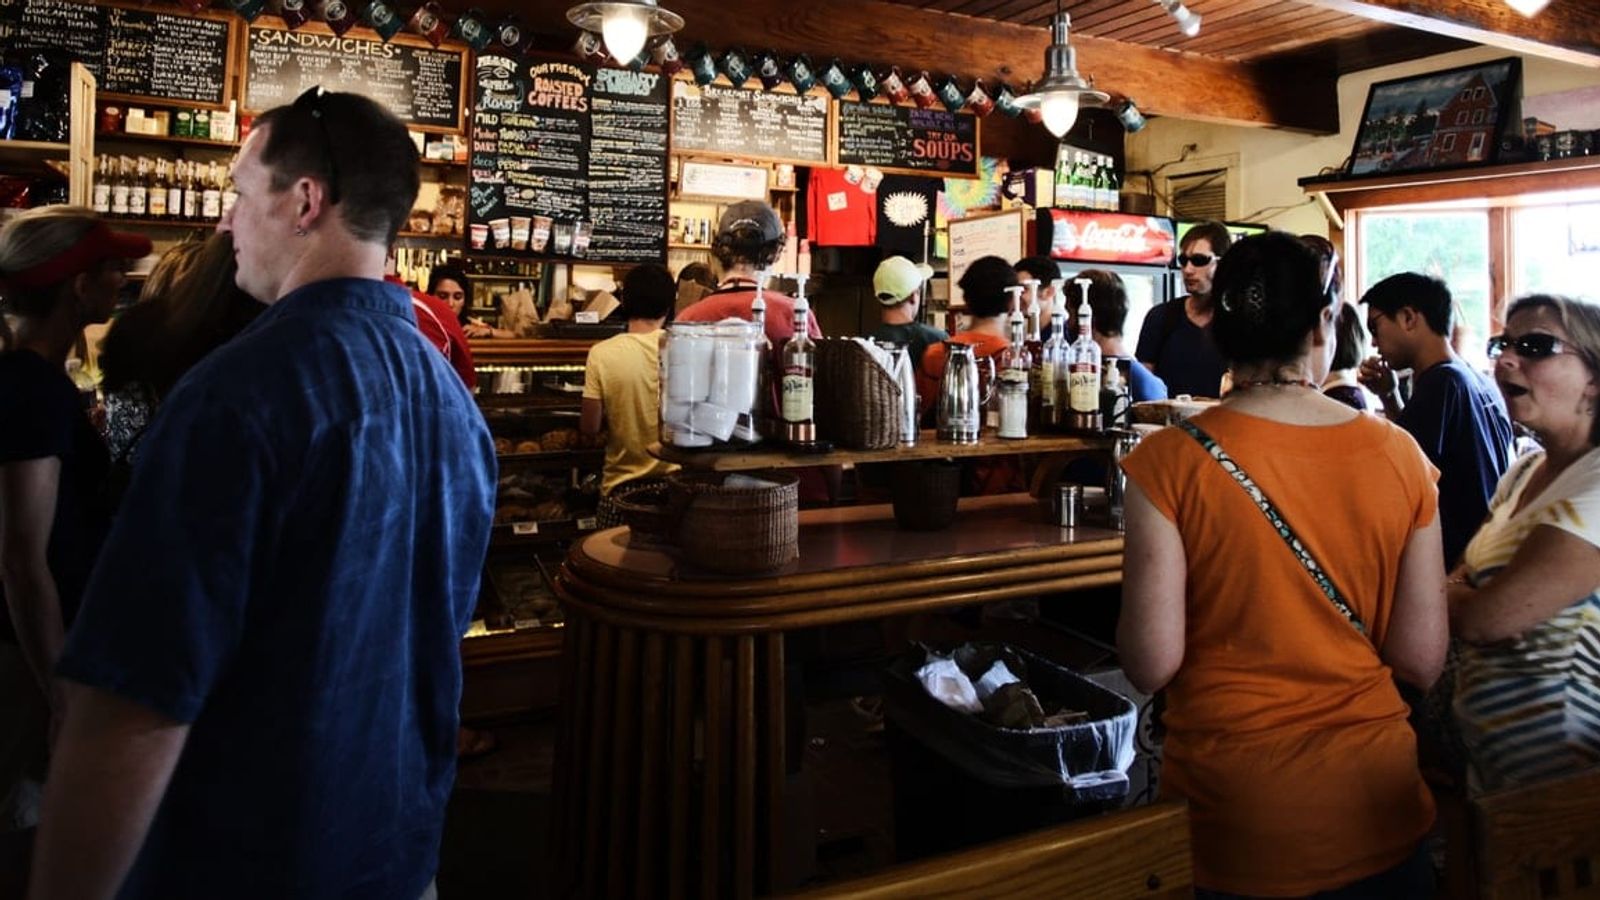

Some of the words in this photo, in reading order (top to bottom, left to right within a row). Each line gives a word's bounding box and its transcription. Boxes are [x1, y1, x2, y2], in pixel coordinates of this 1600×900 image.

[257, 29, 395, 58] SANDWICHES
[530, 63, 549, 79] OUR
[549, 63, 591, 87] FRESHLY
[534, 77, 583, 97] ROASTED
[528, 91, 588, 112] COFFEES
[475, 113, 498, 126] MILD
[913, 138, 973, 162] SOUPS
